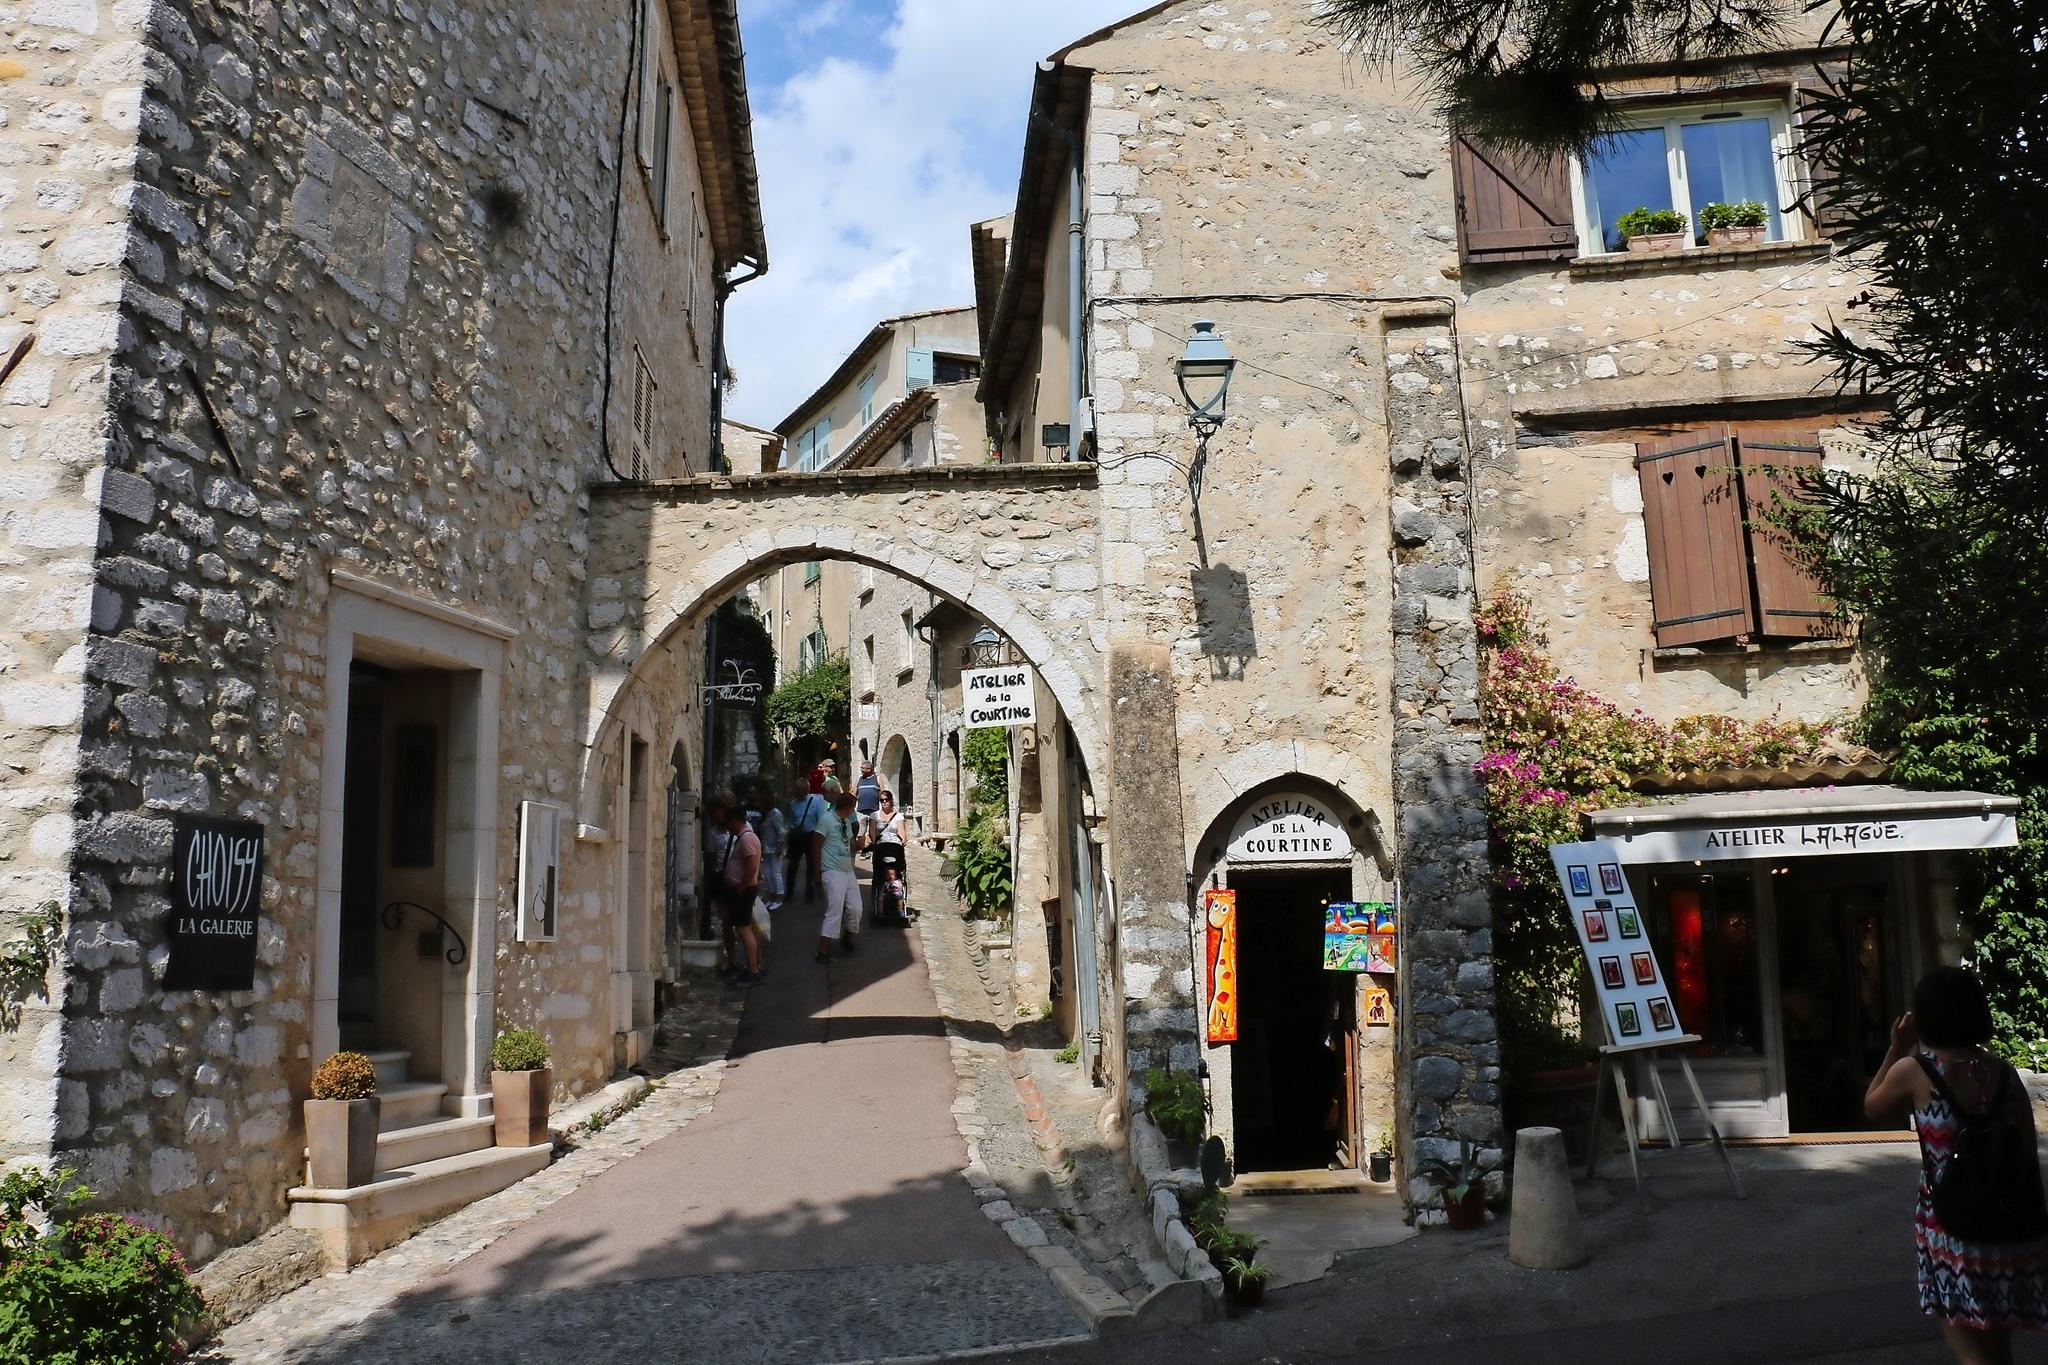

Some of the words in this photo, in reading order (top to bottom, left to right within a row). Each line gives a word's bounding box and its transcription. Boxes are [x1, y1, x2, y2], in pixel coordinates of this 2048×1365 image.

[985, 694, 997, 702] de
[1000, 693, 1011, 702] la
[1251, 800, 1325, 827] ATELIER
[1272, 823, 1285, 833] DE
[1292, 823, 1305, 833] LA
[1706, 828, 1785, 848] ATELIER
[1246, 838, 1332, 853] COURTINE
[187, 829, 259, 914] CHOISY
[178, 918, 196, 934] LA
[200, 918, 254, 938] GALERIE
